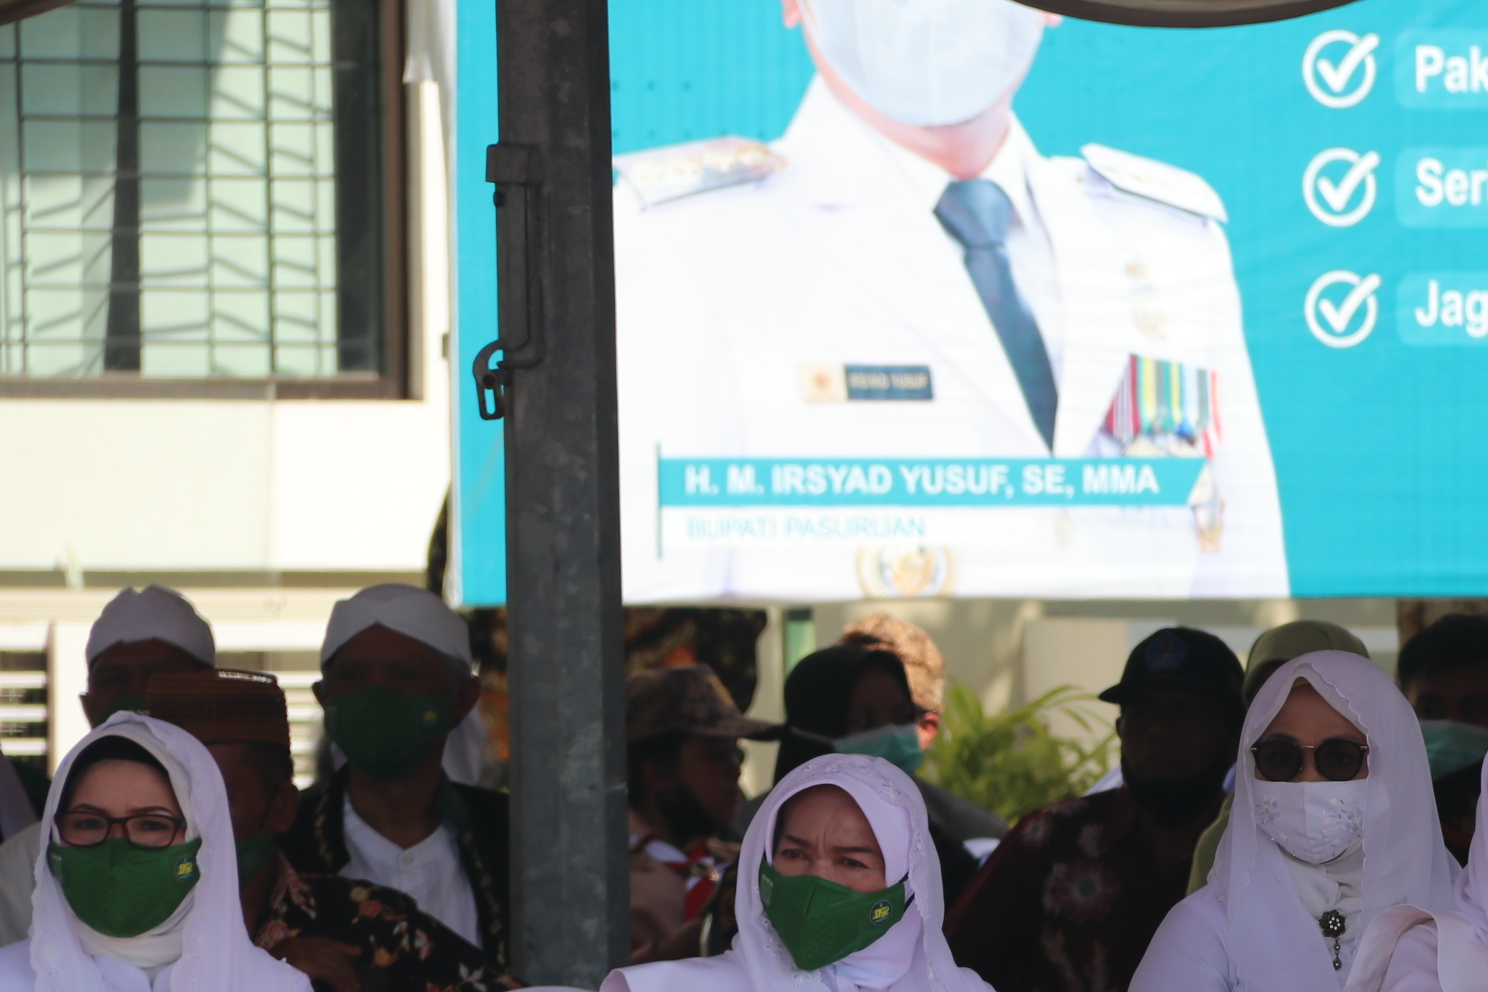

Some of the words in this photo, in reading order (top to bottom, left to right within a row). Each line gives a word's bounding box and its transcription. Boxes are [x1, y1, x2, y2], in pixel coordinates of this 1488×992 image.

[685, 464, 720, 494] H.
[727, 464, 765, 494] M.
[771, 464, 893, 495] IRSYAD
[899, 464, 1015, 499] YUSUF,
[1022, 464, 1075, 499] SE,
[1082, 464, 1160, 495] MMA
[687, 516, 778, 538] BUPATI
[785, 515, 927, 538] PASURUAN
